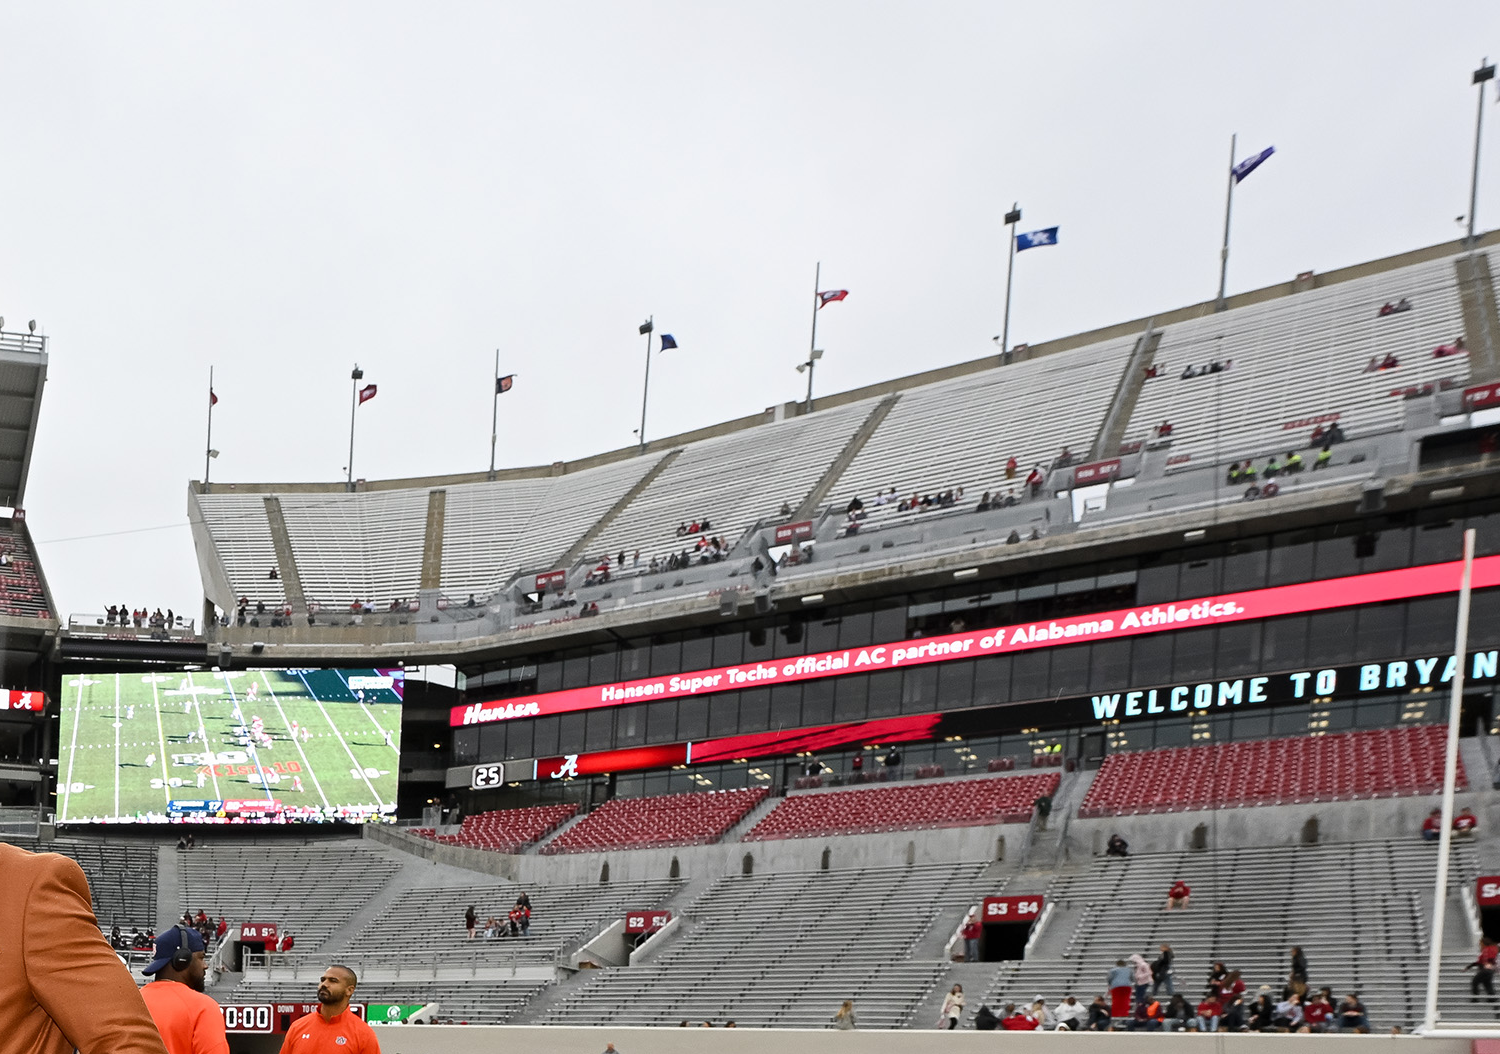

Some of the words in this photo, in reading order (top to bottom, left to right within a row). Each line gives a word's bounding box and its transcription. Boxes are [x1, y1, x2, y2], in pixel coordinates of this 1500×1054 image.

[463, 701, 540, 725] Hansen
[601, 681, 665, 702] Hansen
[669, 673, 722, 696] Super
[726, 664, 778, 685] Techs
[782, 647, 849, 677] official
[854, 647, 886, 666] AC
[892, 636, 974, 665] partner
[979, 630, 1006, 649] of
[1009, 617, 1115, 646] Alabama
[1120, 600, 1245, 630] Athletics.
[1091, 675, 1270, 721] WELCOME
[1289, 668, 1337, 698] TO
[1359, 650, 1499, 691] BRYAN
[274, 761, 302, 774] 10
[475, 766, 500, 786] 25
[1482, 883, 1500, 898] S
[987, 902, 1008, 915] S3
[1017, 901, 1039, 914] S4
[629, 916, 644, 928] S2
[652, 916, 667, 926] S3
[243, 927, 257, 937] AA
[277, 1004, 295, 1013] DOWN
[302, 1004, 310, 1013] TO
[219, 1006, 269, 1029] 0:00
